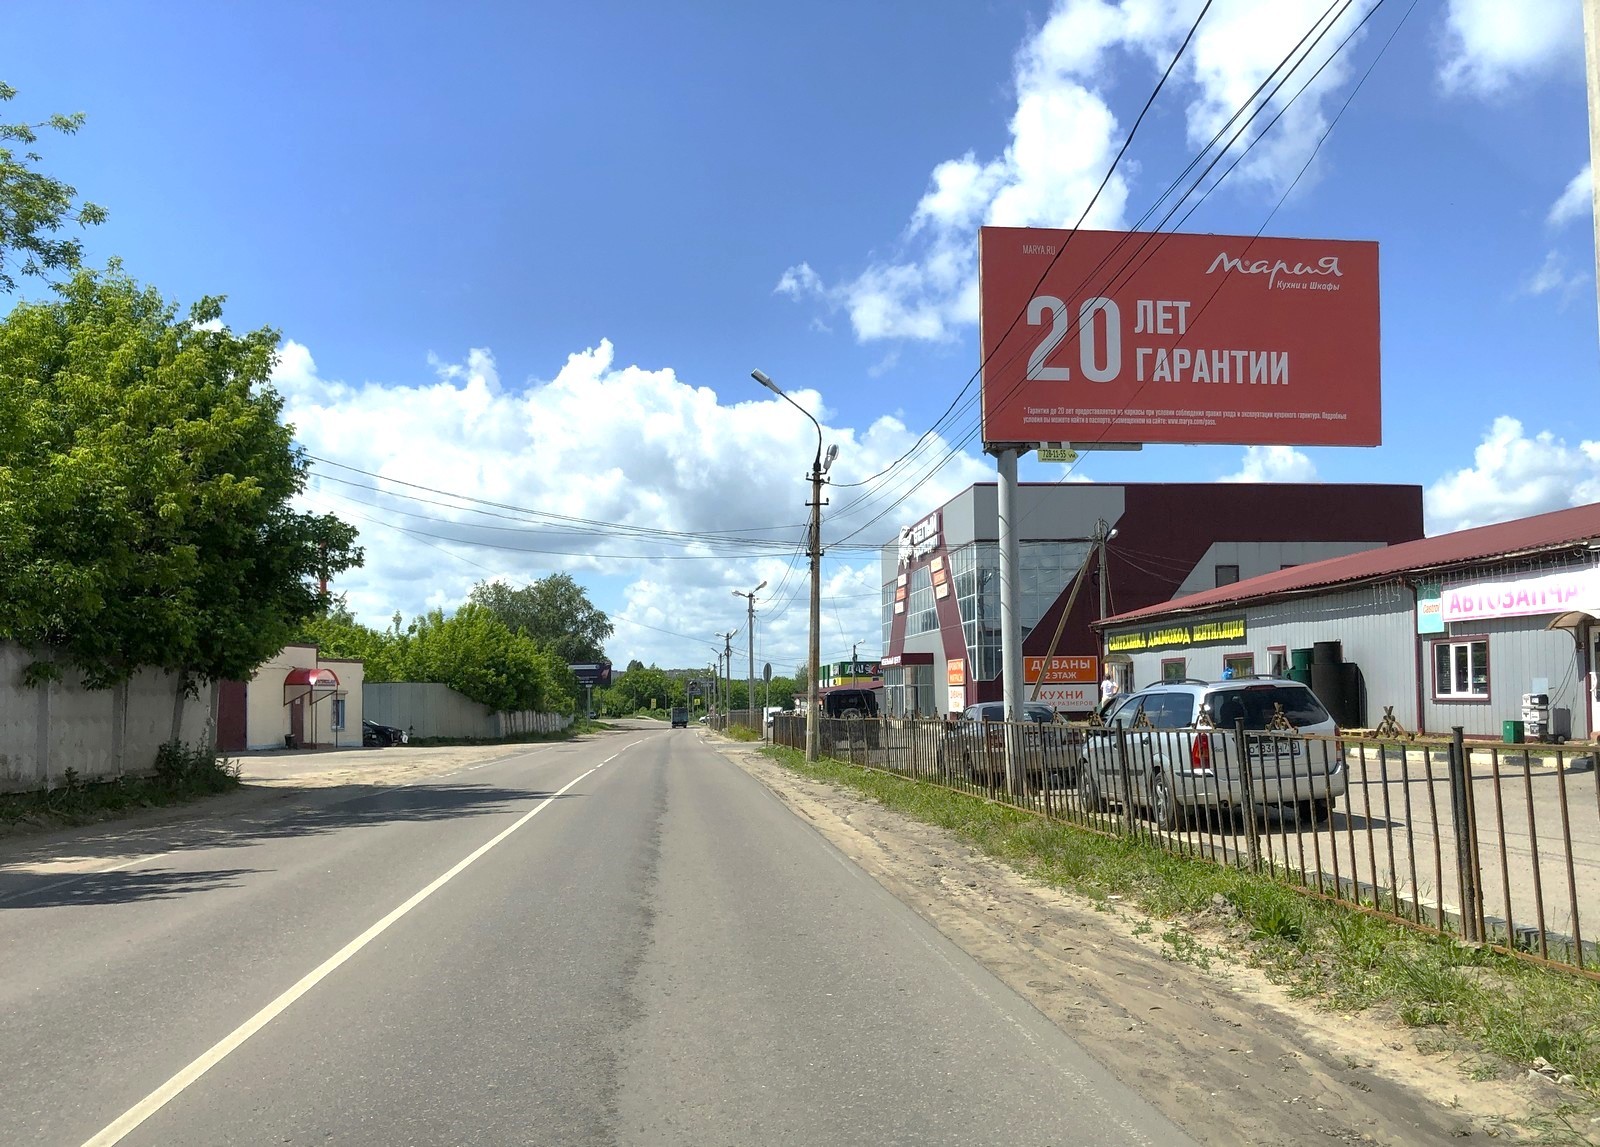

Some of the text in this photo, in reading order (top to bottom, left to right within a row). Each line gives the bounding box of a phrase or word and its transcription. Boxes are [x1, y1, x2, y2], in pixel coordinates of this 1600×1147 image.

[1022, 244, 1056, 256] MARYA.RU
[1206, 252, 1343, 289] Мария
[1277, 280, 1301, 291] Кухни
[1309, 281, 1340, 292] Шкафы
[1134, 299, 1191, 335] ЛЕТ
[1026, 295, 1122, 383] 20
[1136, 347, 1289, 385] ГАРАНТИИ
[1148, 627, 1191, 648] ДЫМОХОД
[1031, 660, 1090, 671] ДВАНЫ
[1040, 690, 1084, 700] КУХНИ
